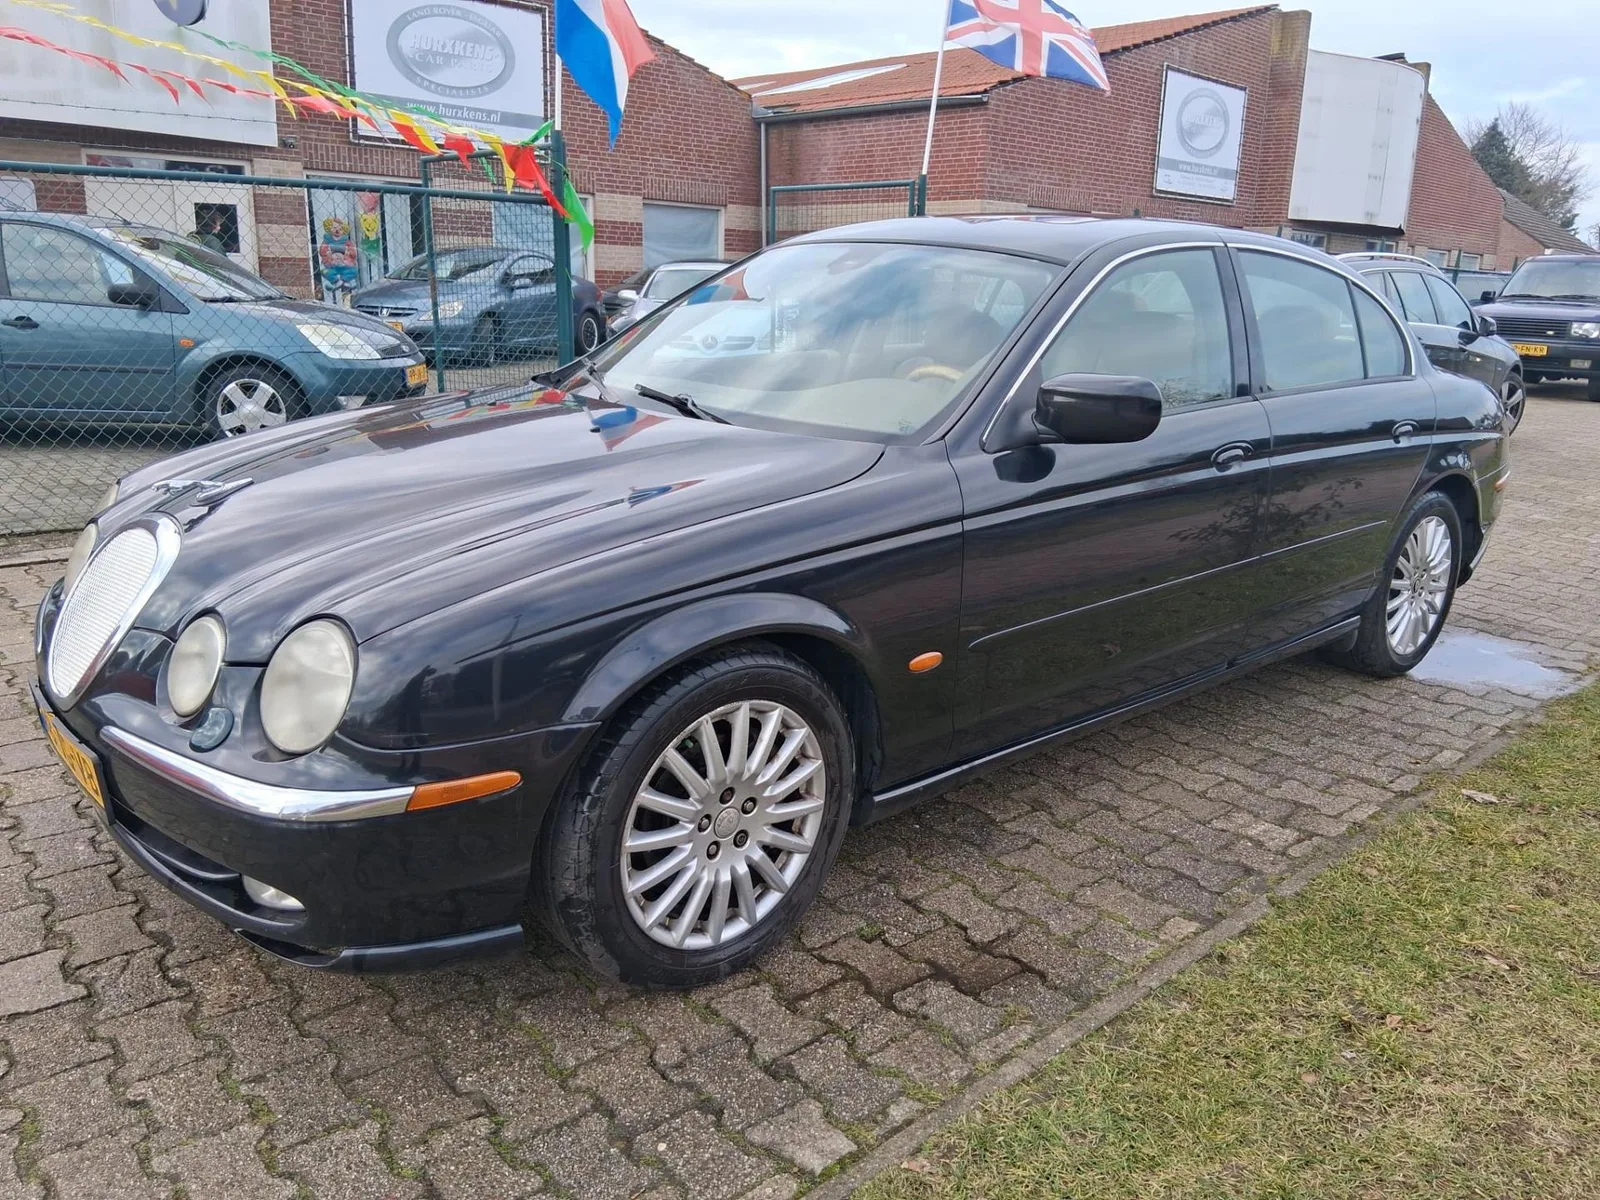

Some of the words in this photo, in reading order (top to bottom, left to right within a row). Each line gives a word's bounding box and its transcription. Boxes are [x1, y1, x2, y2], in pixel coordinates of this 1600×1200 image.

[407, 8, 431, 21] LAND
[410, 36, 494, 61] HURXKENS
[415, 52, 444, 66] CAR
[415, 75, 490, 97] SPECIALISTS
